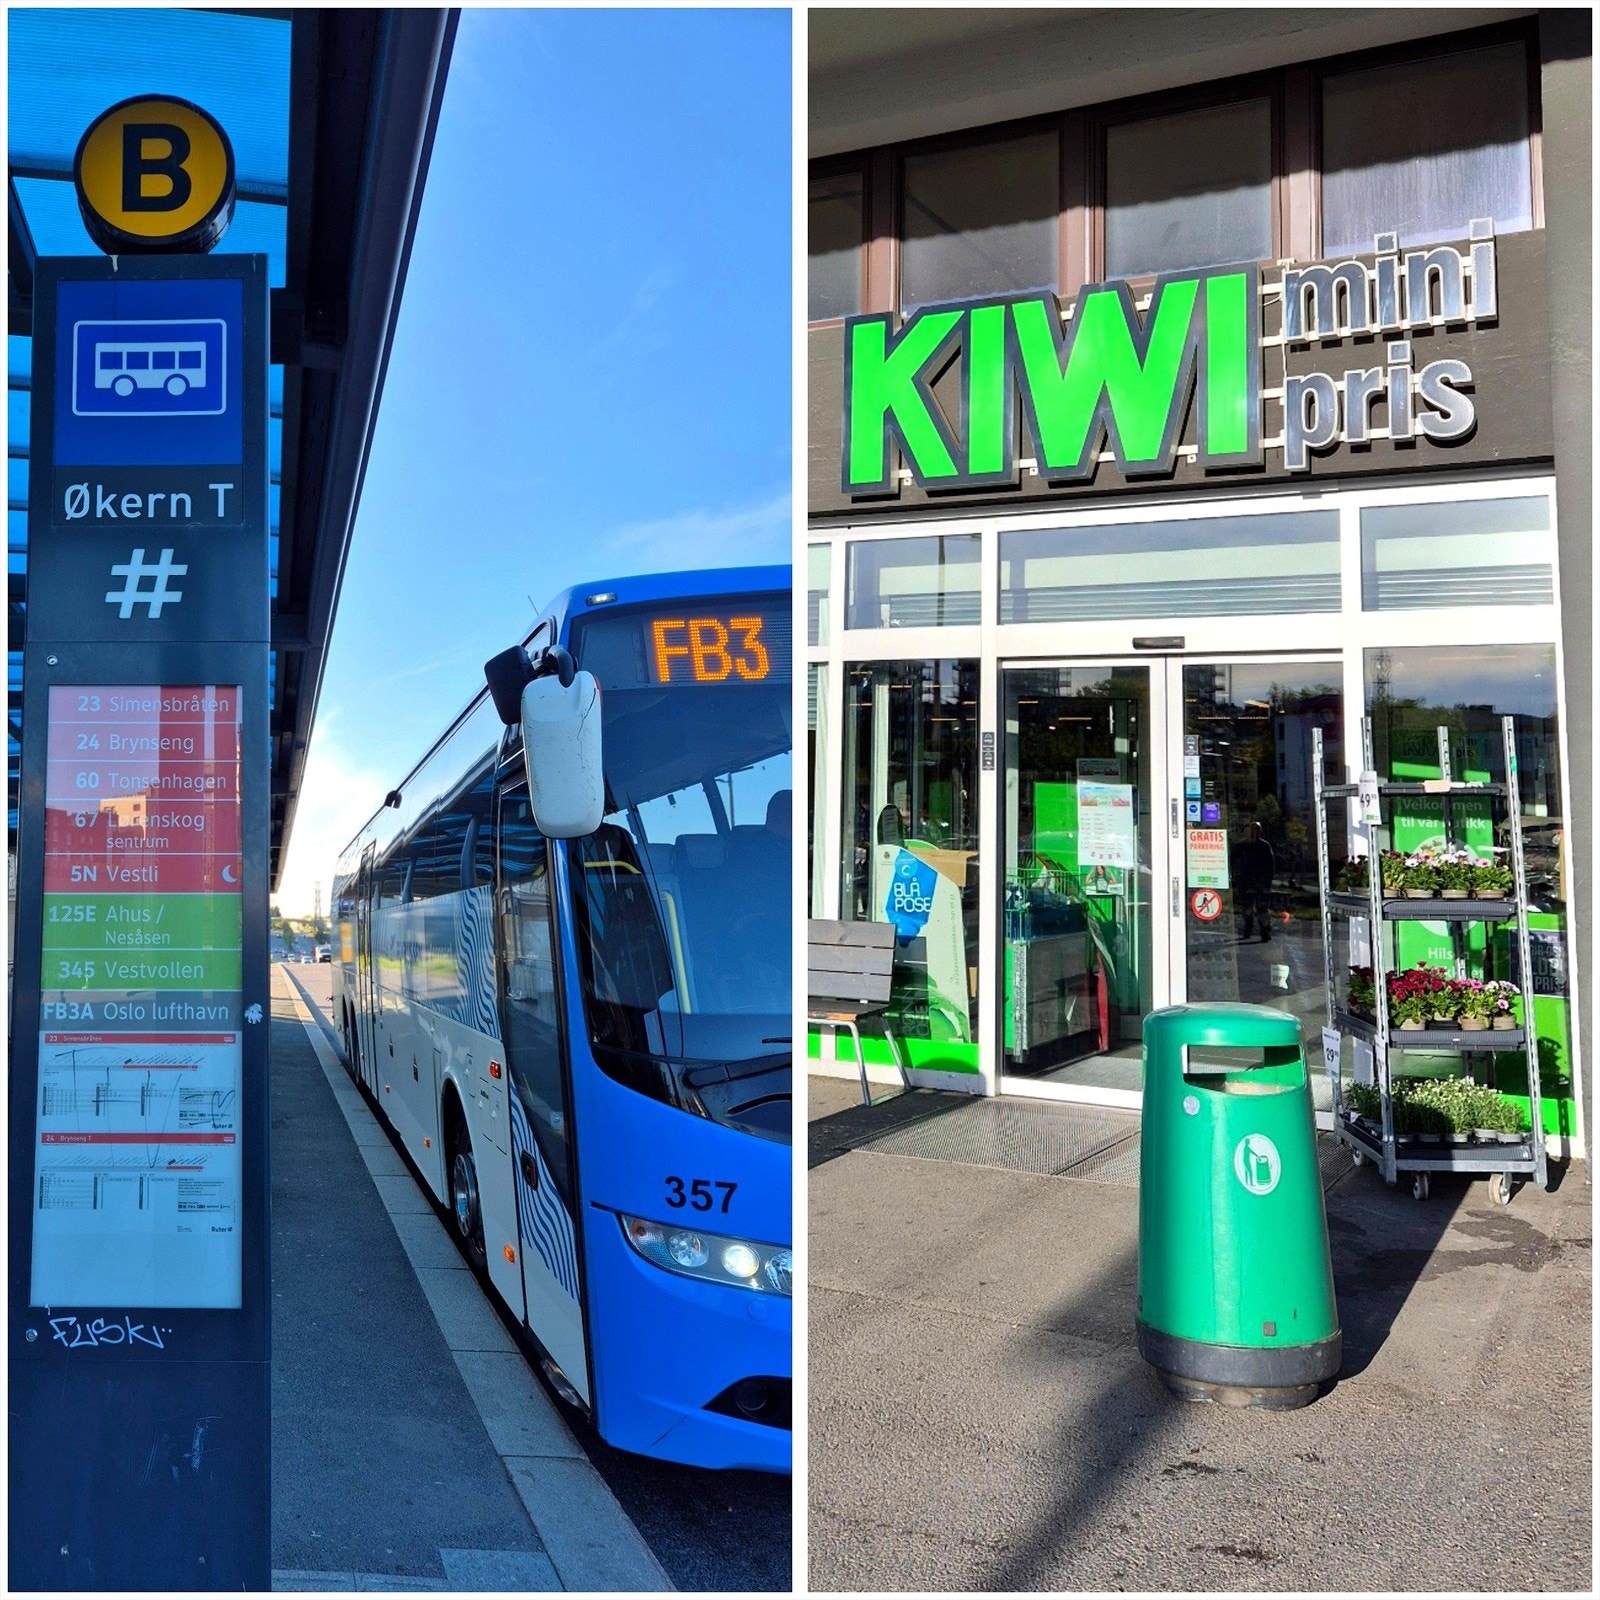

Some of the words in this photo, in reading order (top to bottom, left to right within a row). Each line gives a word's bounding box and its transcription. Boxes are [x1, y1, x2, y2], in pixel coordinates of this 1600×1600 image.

[122, 124, 192, 212] B
[1282, 217, 1496, 341] mini
[846, 268, 1256, 489] KIWI
[1283, 340, 1476, 470] pris
[64, 483, 191, 520] Økern
[209, 484, 234, 517] T
[653, 617, 770, 682] FB3
[78, 696, 100, 712] 23
[110, 695, 229, 712] Simensbråten
[76, 734, 99, 750] 24
[109, 734, 194, 753] Brynseng
[75, 772, 99, 788] 60
[109, 772, 226, 792] Tonsenhagen
[75, 811, 98, 827] 67
[1401, 817, 1414, 828] til
[1418, 819, 1437, 828] vår
[106, 836, 168, 848] sentrum
[1190, 832, 1224, 842] GRATIS
[1190, 843, 1224, 851] PARKERING
[70, 866, 97, 882] 5N
[106, 866, 158, 882] Vestli
[894, 877, 920, 897] BLÅ
[894, 898, 931, 912] POSE
[49, 906, 96, 922] 125E
[105, 906, 150, 922] Ahus
[105, 929, 170, 944] Nesåsen
[59, 962, 95, 978] 345
[105, 961, 204, 978] Vestvollen
[43, 1003, 94, 1020] FB3A
[103, 1003, 145, 1020] Oslo
[152, 1003, 229, 1020] lufthavn
[60, 1135, 86, 1143] Brynseng
[665, 1176, 738, 1213] 357
